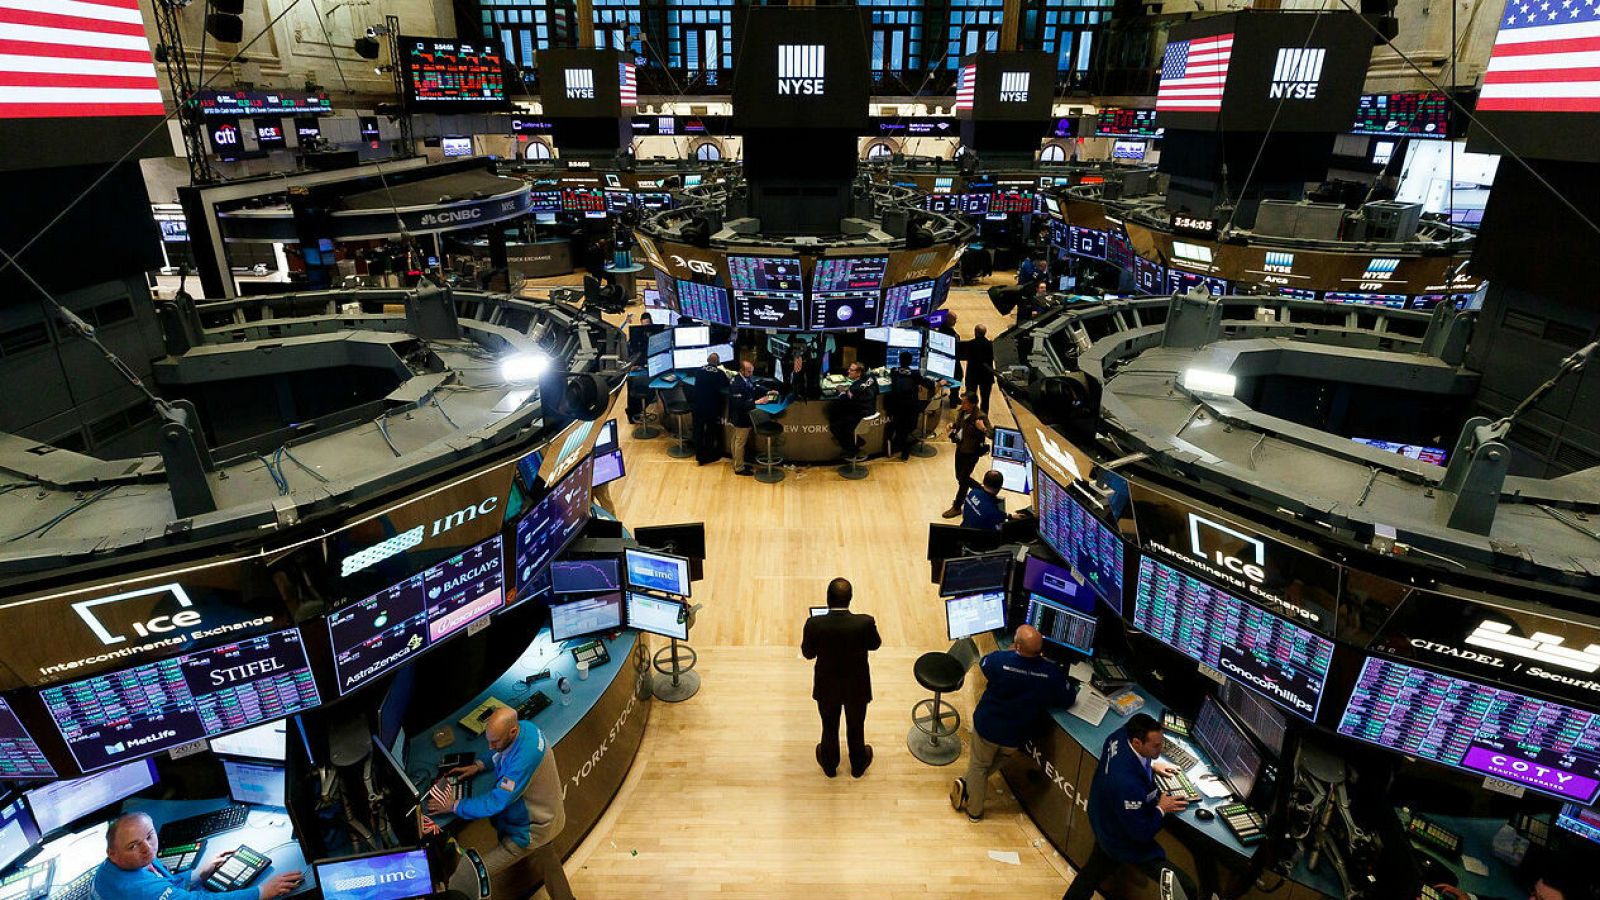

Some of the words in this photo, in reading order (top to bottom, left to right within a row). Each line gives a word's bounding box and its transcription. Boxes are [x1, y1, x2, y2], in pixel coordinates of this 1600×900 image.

[567, 88, 594, 99] NYSE
[778, 80, 824, 95] NYSE
[1270, 83, 1317, 99] NYSE
[1000, 92, 1027, 102] NYSE
[215, 126, 237, 144] citi
[437, 208, 481, 223] CNBC
[1174, 216, 1212, 231] 3:54:05
[688, 260, 716, 276] GTS
[1264, 264, 1292, 274] NYSE
[1362, 272, 1393, 280] NYSE
[1264, 274, 1289, 285] Arca
[1359, 282, 1383, 290] UTP
[802, 425, 829, 433] YORK
[443, 557, 499, 593] BARCLAYS
[1150, 539, 1246, 589] Intercontinental
[1249, 584, 1319, 623] Exchange
[39, 634, 186, 676] Intercontinental
[191, 615, 274, 640] Exchange
[210, 656, 285, 687] STIFEL
[346, 647, 410, 686] AstraZeneca
[1410, 638, 1505, 668] CITADEL
[1526, 667, 1600, 692] Securit
[1220, 657, 1313, 713] ConocoPhillips
[126, 728, 176, 749] MetLife
[571, 742, 608, 787] YORK
[1491, 755, 1573, 784] COTY
[1045, 761, 1089, 813] EXCH
